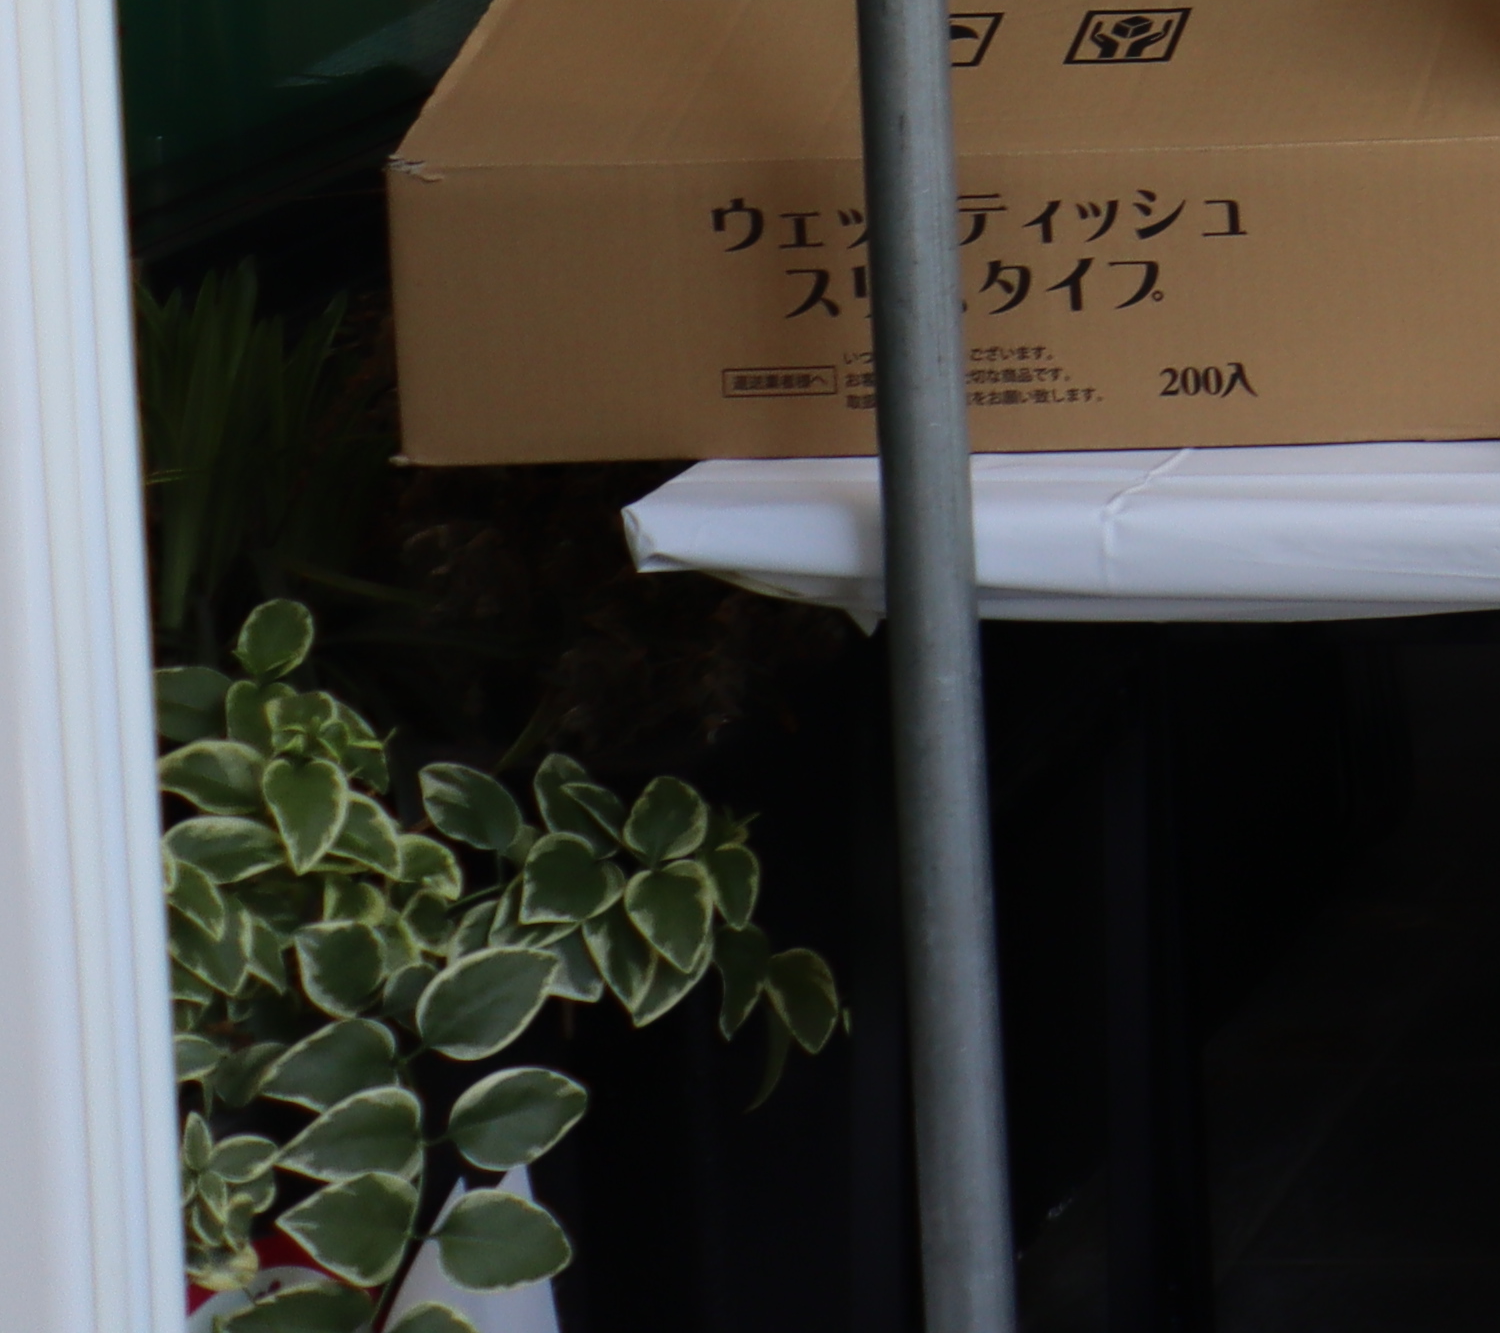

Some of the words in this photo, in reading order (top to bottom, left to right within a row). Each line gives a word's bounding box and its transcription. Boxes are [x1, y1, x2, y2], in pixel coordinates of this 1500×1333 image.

[709, 187, 1249, 253] ウェッティッシュ
[784, 257, 1165, 319] スタイプ
[1158, 361, 1258, 399] 200入
